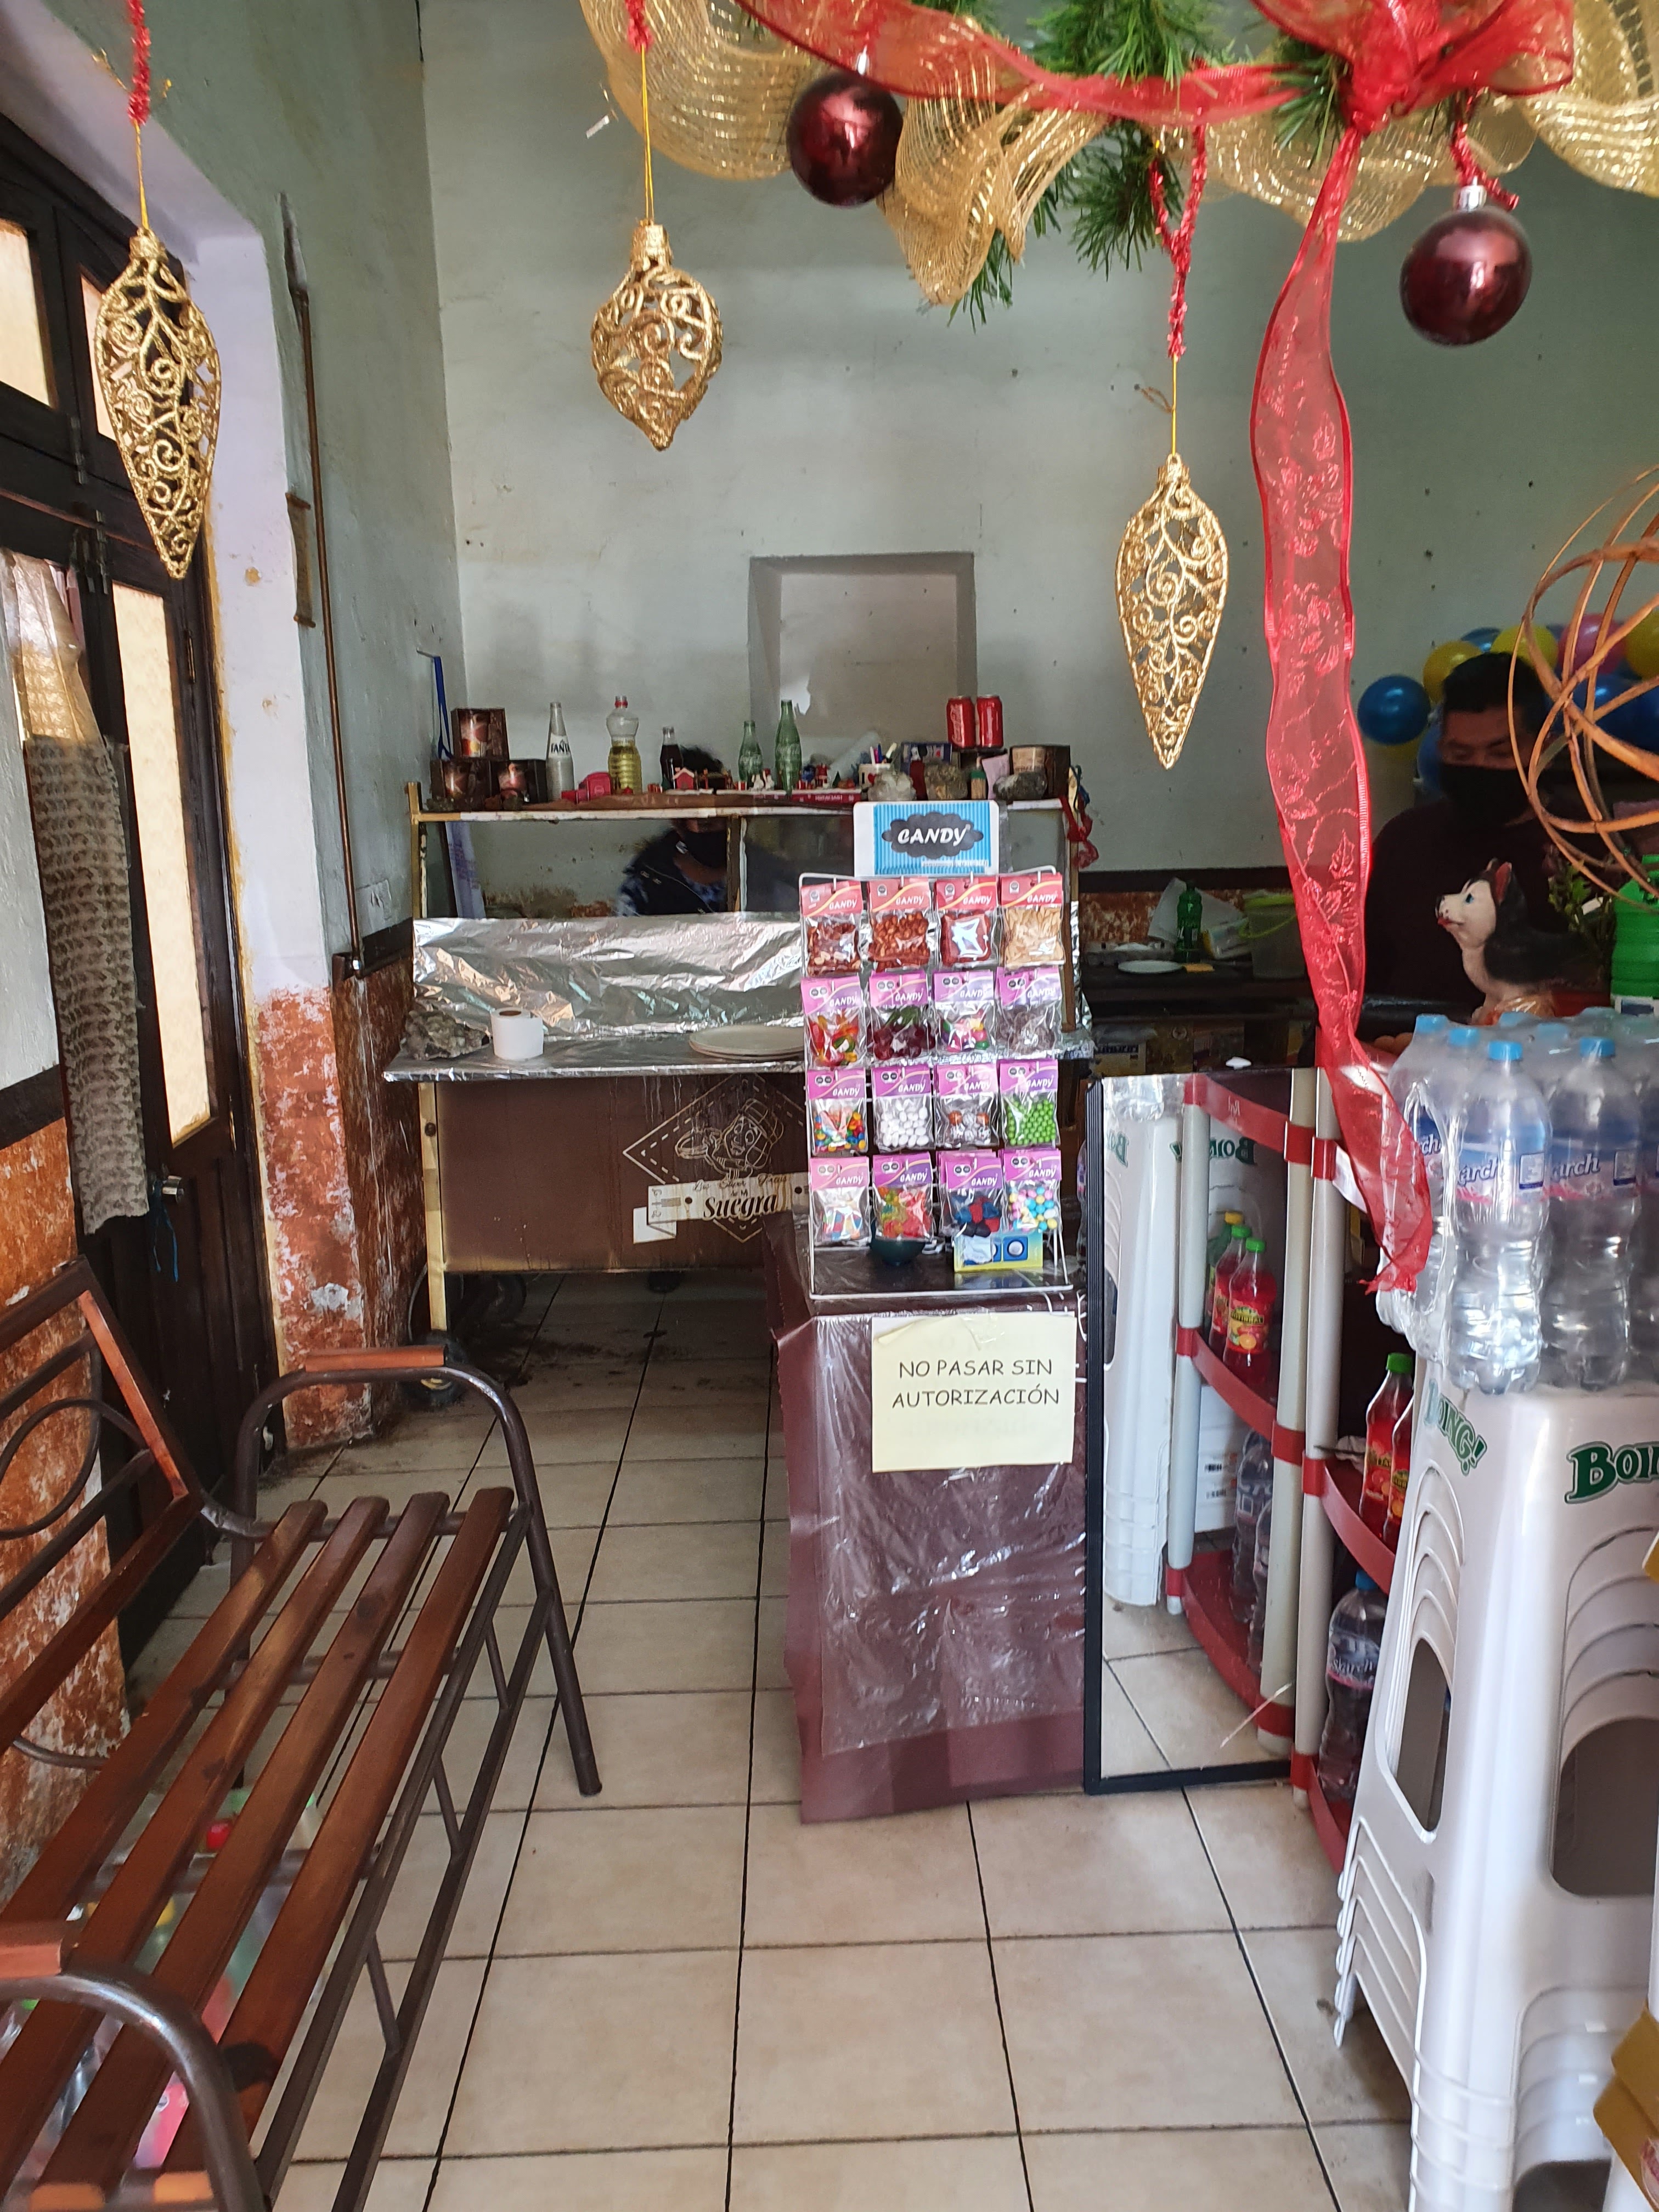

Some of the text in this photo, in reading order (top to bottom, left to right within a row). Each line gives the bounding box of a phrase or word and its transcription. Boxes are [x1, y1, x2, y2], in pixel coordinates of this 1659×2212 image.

[898, 827, 967, 847] CANDY
[896, 895, 923, 905] CANDY
[963, 895, 992, 905] CANDY
[1028, 894, 1057, 904] CANDY
[829, 899, 857, 910] CANDY
[830, 995, 857, 1007] CANDY
[895, 992, 923, 1002] CANDY
[899, 1083, 925, 1093] CANDY
[1026, 1078, 1053, 1088] CANDY
[833, 1087, 860, 1097] CANDY
[900, 1172, 927, 1183] CANDY
[1029, 1169, 1056, 1178] CANDY
[836, 1175, 863, 1185] CANDY
[971, 1177, 997, 1187] CANDY
[704, 1194, 777, 1219] Suegra
[900, 1358, 1052, 1378] NO PASAR SIN
[892, 1383, 1059, 1408] AUTORIZACIÓN
